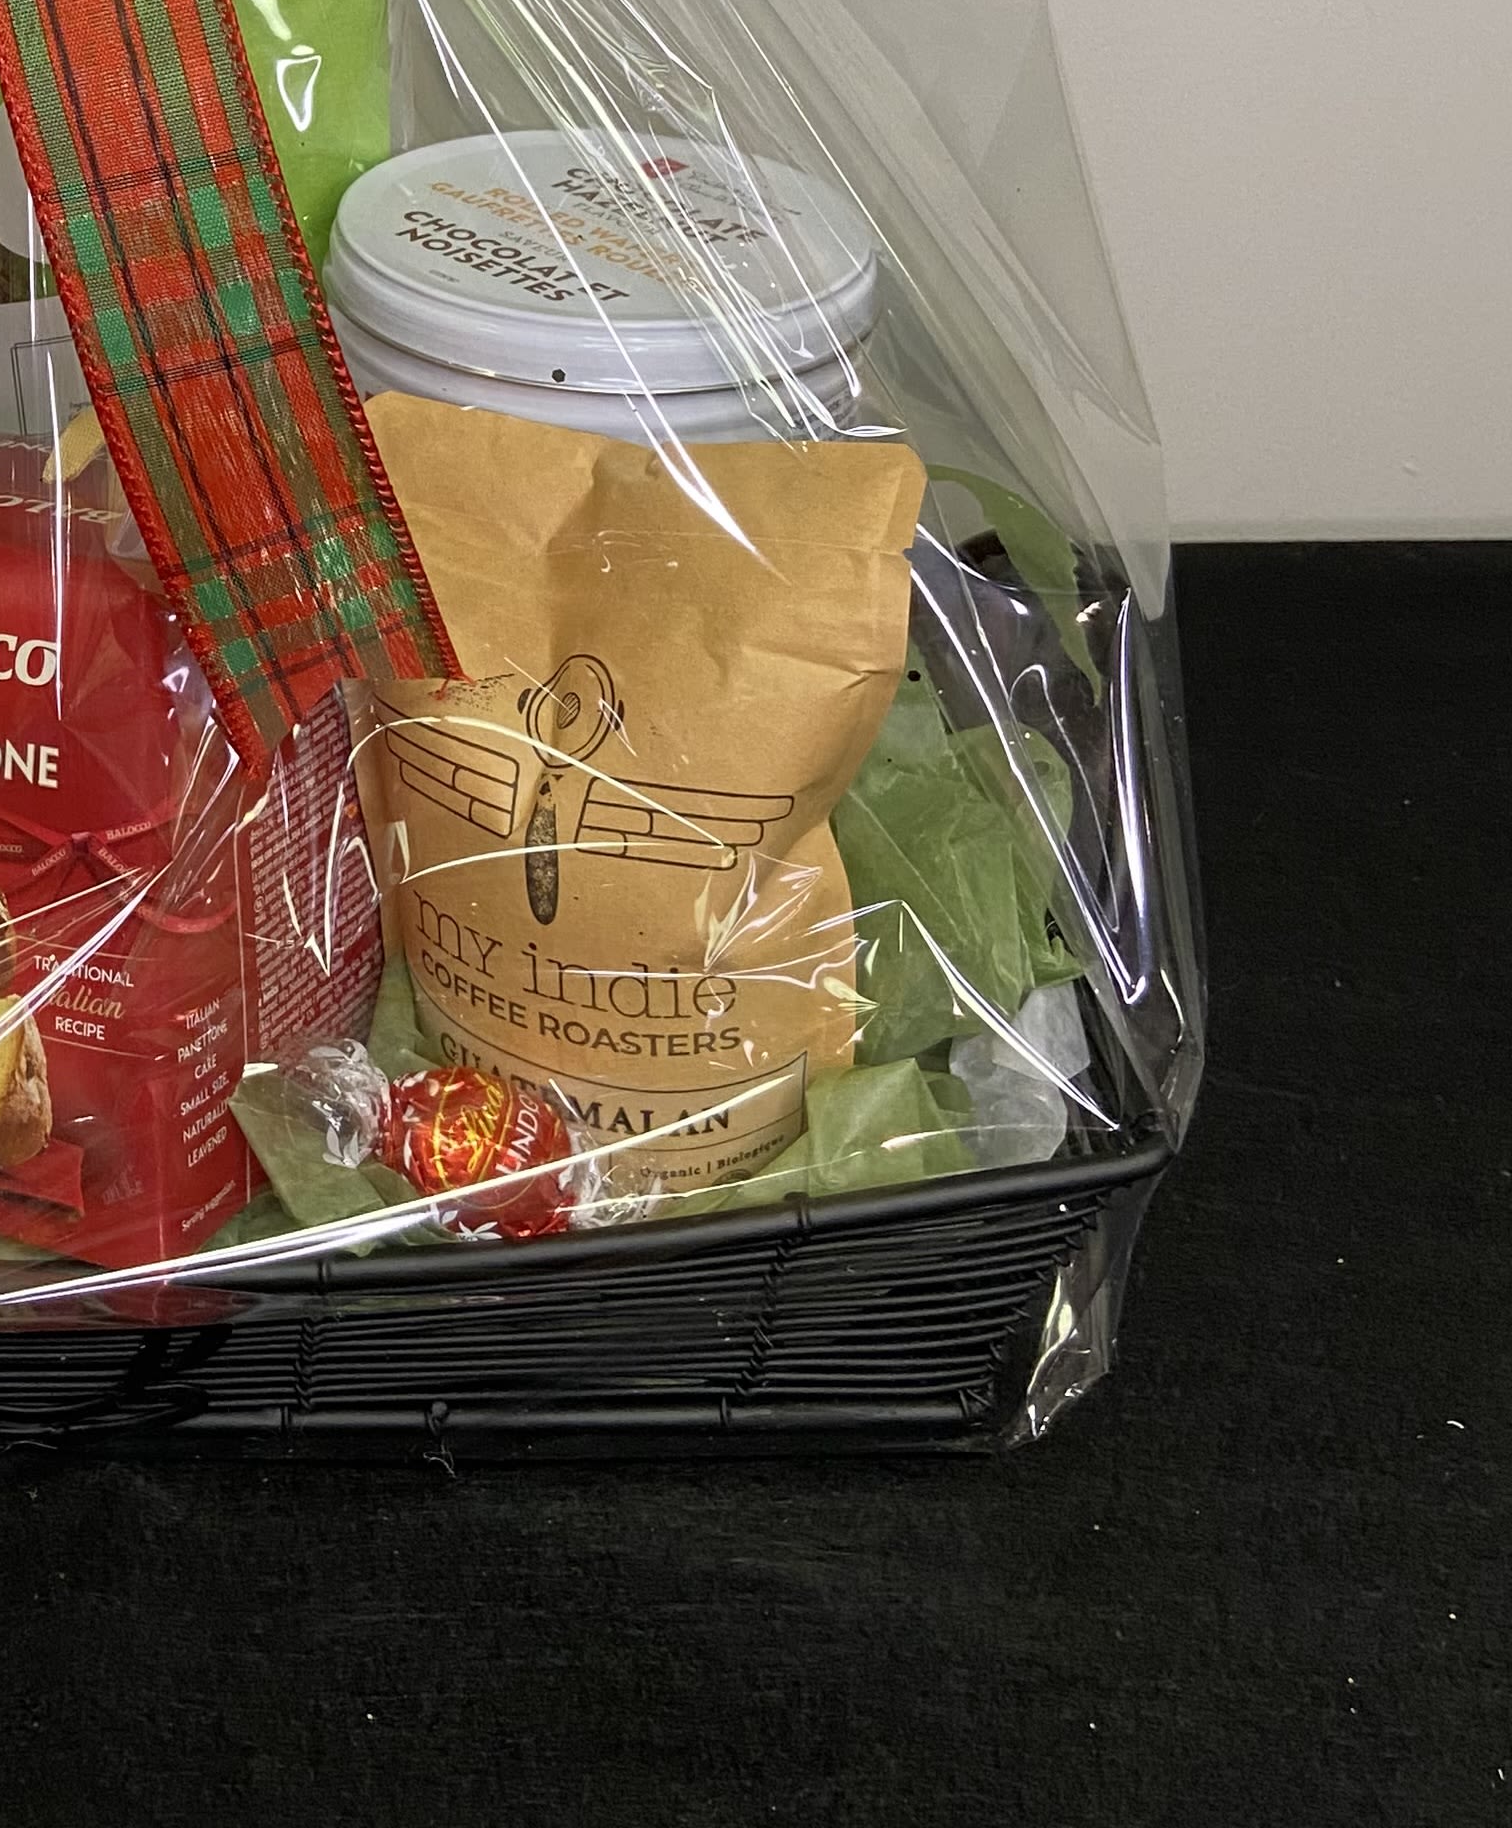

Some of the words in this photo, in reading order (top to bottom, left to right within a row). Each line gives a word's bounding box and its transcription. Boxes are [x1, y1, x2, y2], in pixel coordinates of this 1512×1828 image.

[395, 226, 576, 302] NOISETTES
[403, 210, 579, 283] CHOCOLAT
[577, 281, 630, 301] ET
[33, 955, 135, 988] TRATIONAL
[522, 942, 737, 1020] indie
[44, 984, 126, 1020] alian
[185, 997, 220, 1030] ITALIAN
[421, 949, 529, 1029] COFFEE
[538, 1011, 742, 1058] ROASTERS
[55, 1016, 106, 1041] RECIPE
[177, 1018, 228, 1063] PANETTONE
[180, 1087, 210, 1116] SMALL
[188, 1126, 227, 1167] LEAVENED
[640, 1159, 702, 1182] Oganic
[716, 1134, 785, 1171] Biologique
